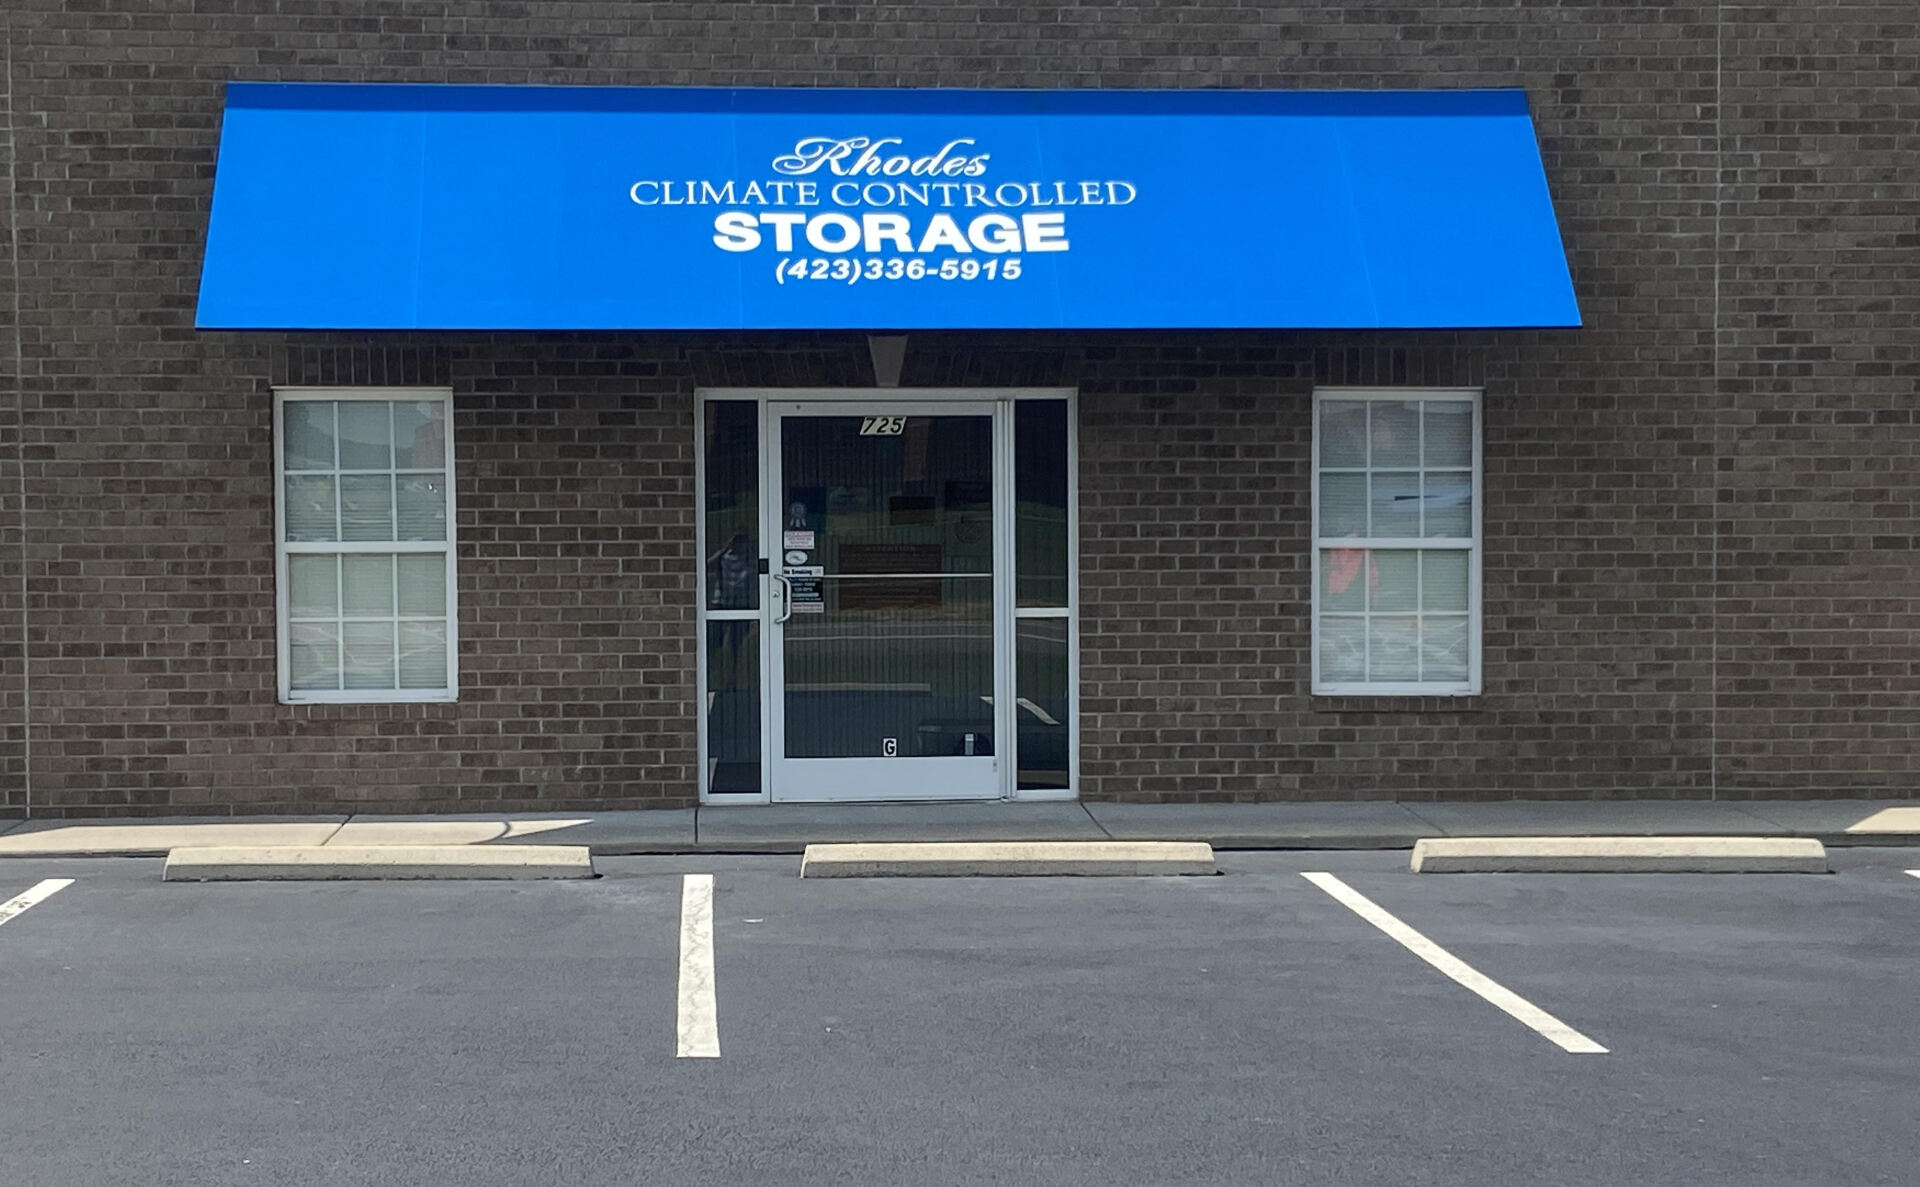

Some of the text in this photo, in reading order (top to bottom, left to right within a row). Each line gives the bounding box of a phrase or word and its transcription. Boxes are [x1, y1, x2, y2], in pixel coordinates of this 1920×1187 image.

[771, 136, 990, 177] Rhodes
[629, 180, 1137, 207] CLIMATE CONTROLLED
[713, 211, 1070, 253] STORAGE
[775, 257, 1023, 285] (423)336-5915
[863, 417, 904, 434] 725
[885, 740, 895, 755] G
